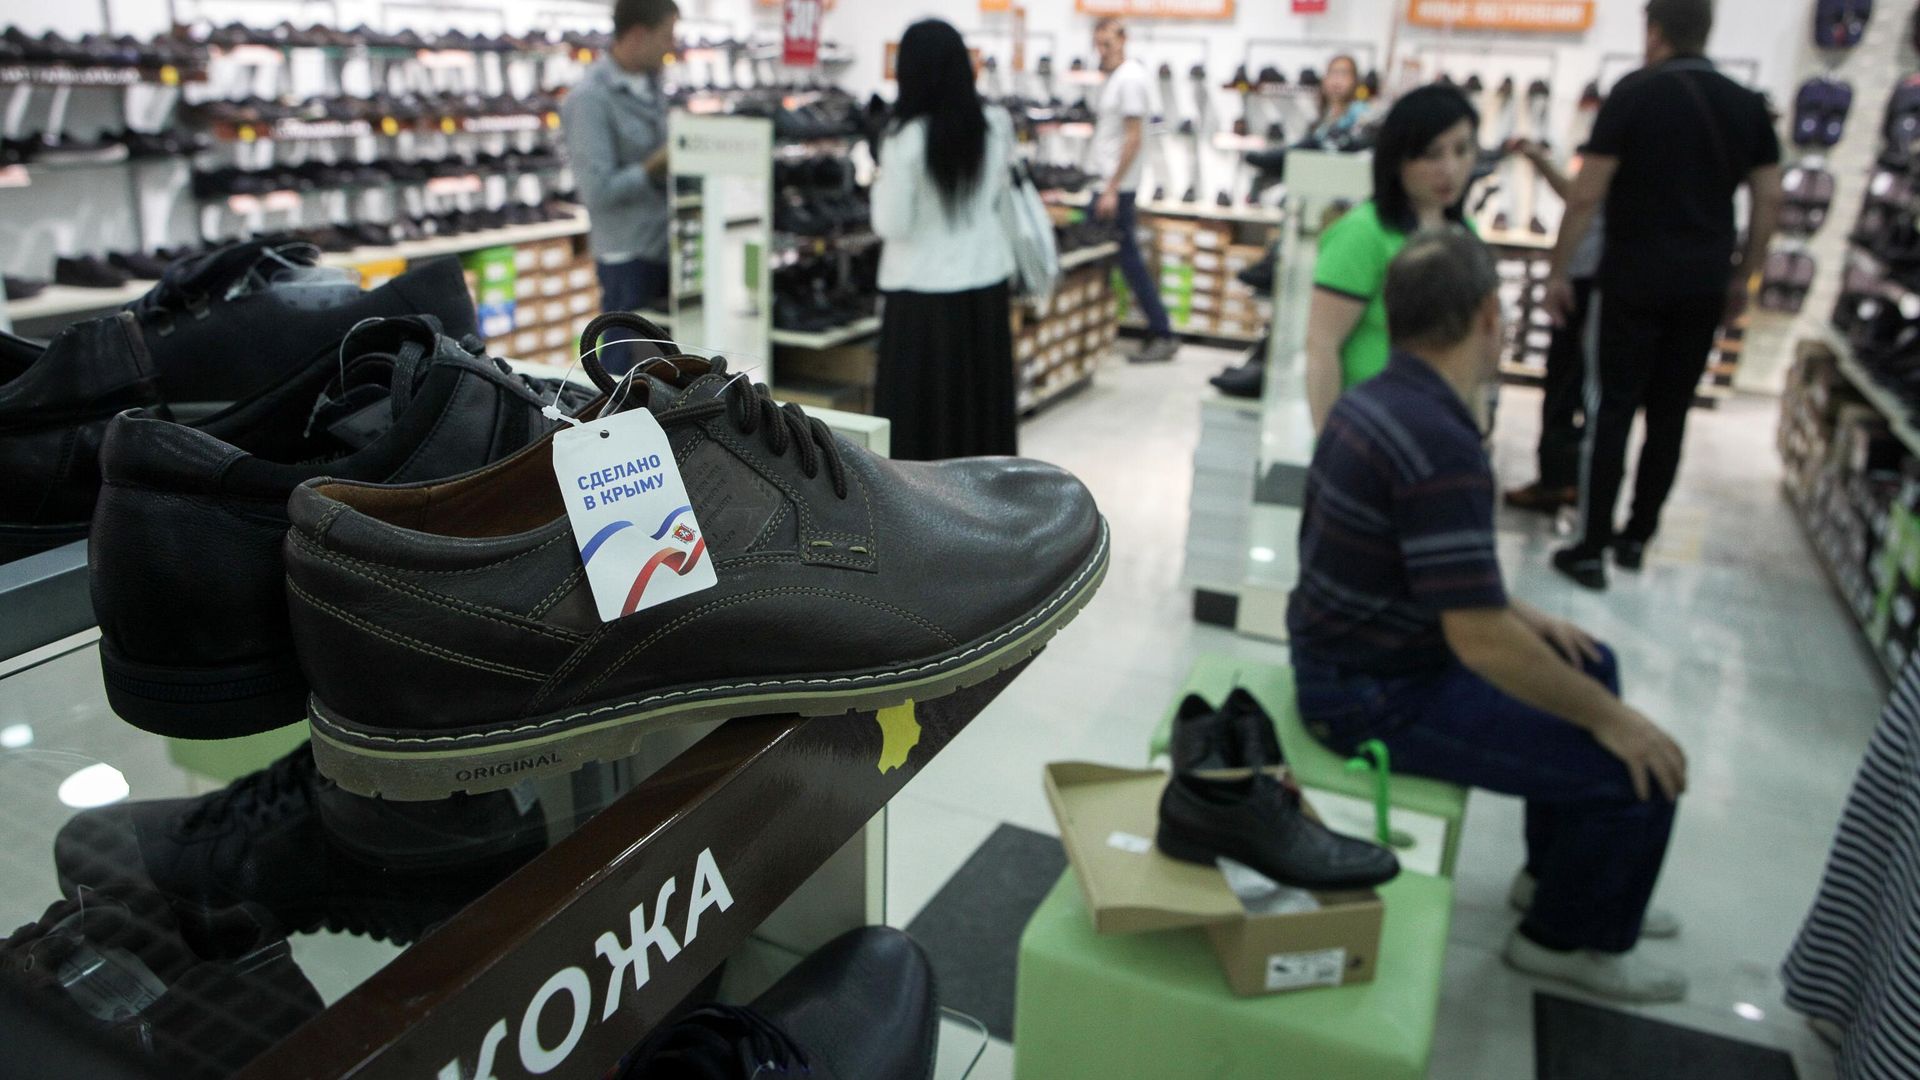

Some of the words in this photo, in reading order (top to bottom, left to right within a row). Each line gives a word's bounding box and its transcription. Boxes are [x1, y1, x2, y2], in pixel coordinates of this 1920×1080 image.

[577, 454, 661, 490] СДЕЛАНО
[583, 495, 597, 511] В
[600, 473, 664, 505] КРЫМУ
[456, 752, 562, 782] ORIGINAL
